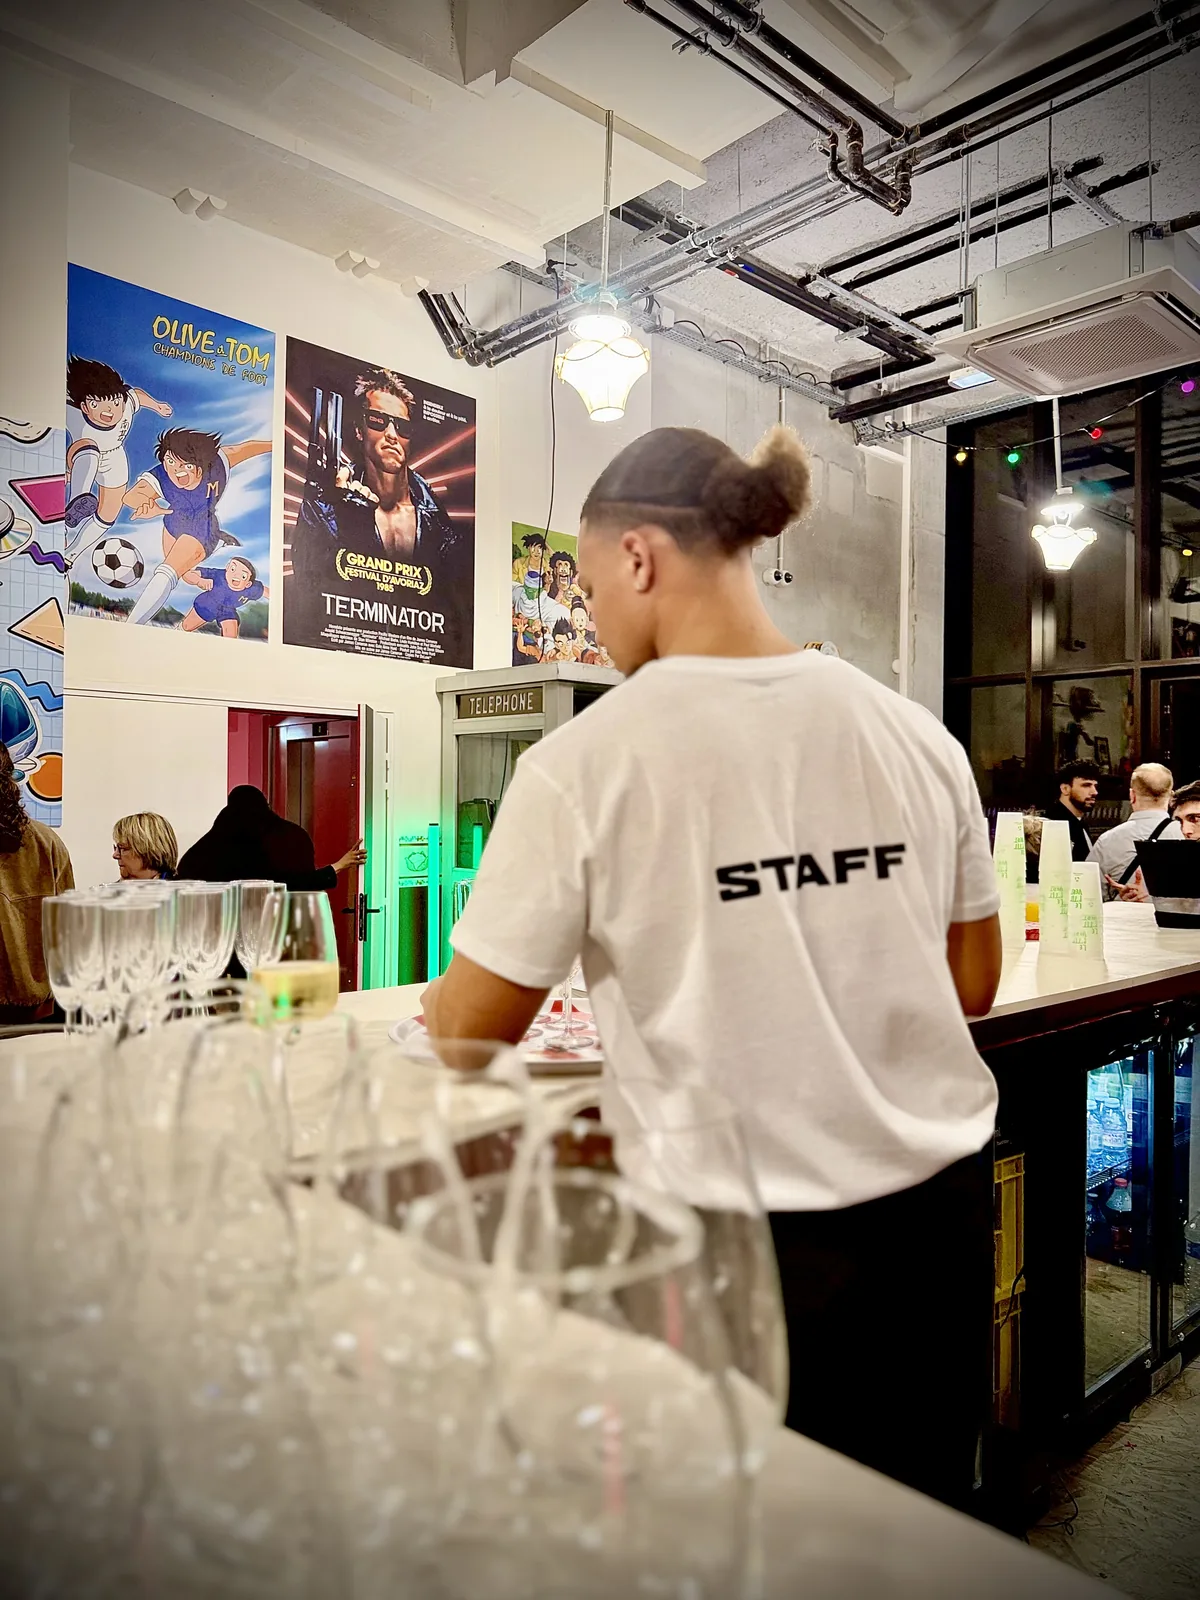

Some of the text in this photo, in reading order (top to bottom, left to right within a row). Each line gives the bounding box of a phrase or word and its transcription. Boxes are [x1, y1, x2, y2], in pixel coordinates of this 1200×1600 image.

[152, 315, 216, 354] OLIVE
[225, 337, 271, 371] TOM
[153, 342, 268, 387] CHAMPIONS DE FOOT
[205, 480, 220, 499] M
[344, 566, 425, 590] FESTIVAL D'AVORIAZ
[346, 552, 422, 579] GRAND PRIX
[376, 581, 395, 593] 1985
[321, 592, 445, 634] TERMINATOR
[469, 692, 534, 715] TELEPHONE
[715, 843, 906, 902] STAFF
